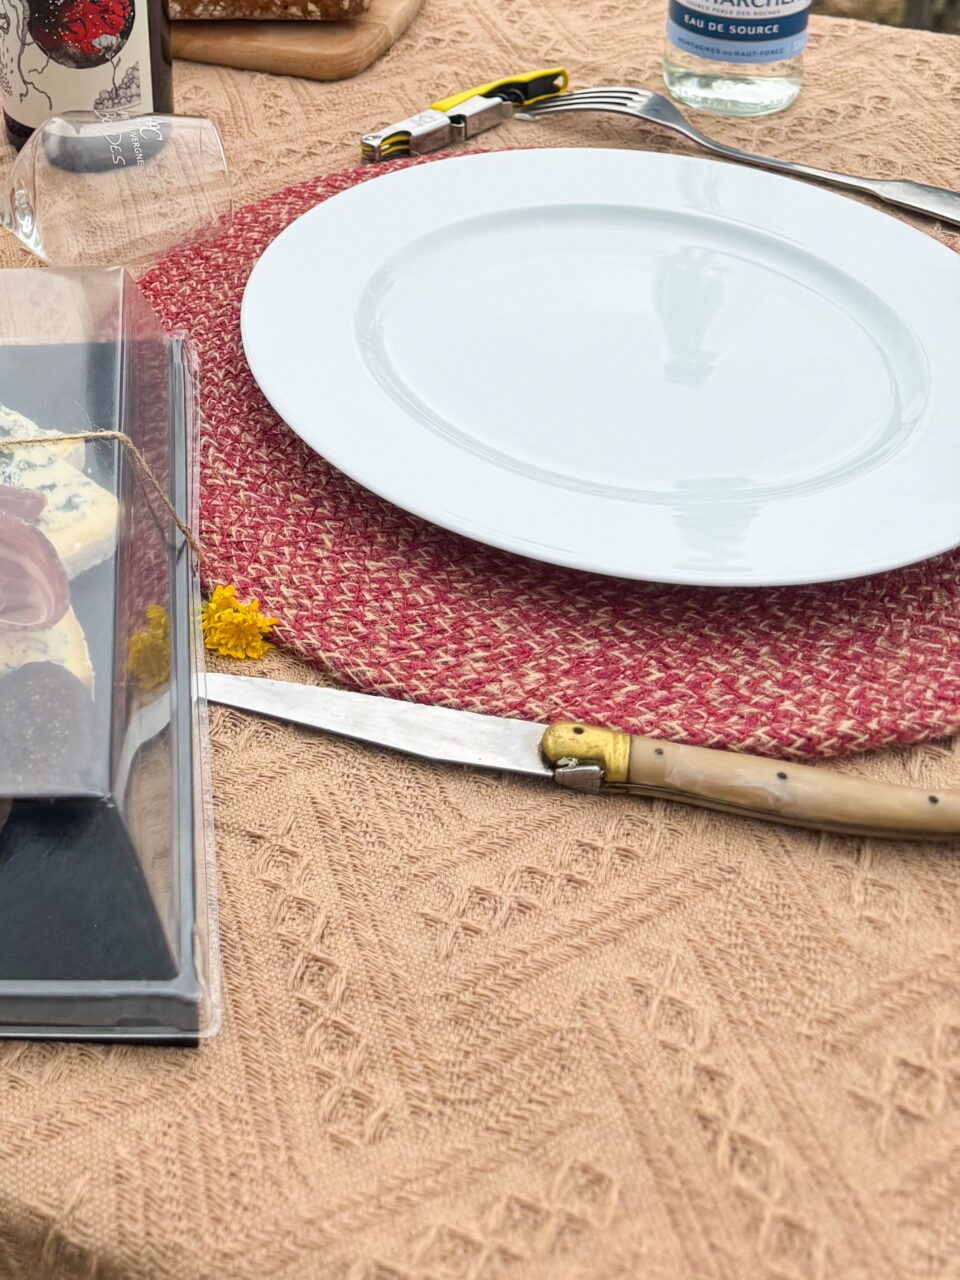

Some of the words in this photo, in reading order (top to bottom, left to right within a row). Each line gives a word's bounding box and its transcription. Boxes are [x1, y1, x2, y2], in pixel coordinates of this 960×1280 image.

[684, 14, 704, 29] EAU
[708, 22, 725, 33] DE
[729, 24, 780, 36] SOURCE
